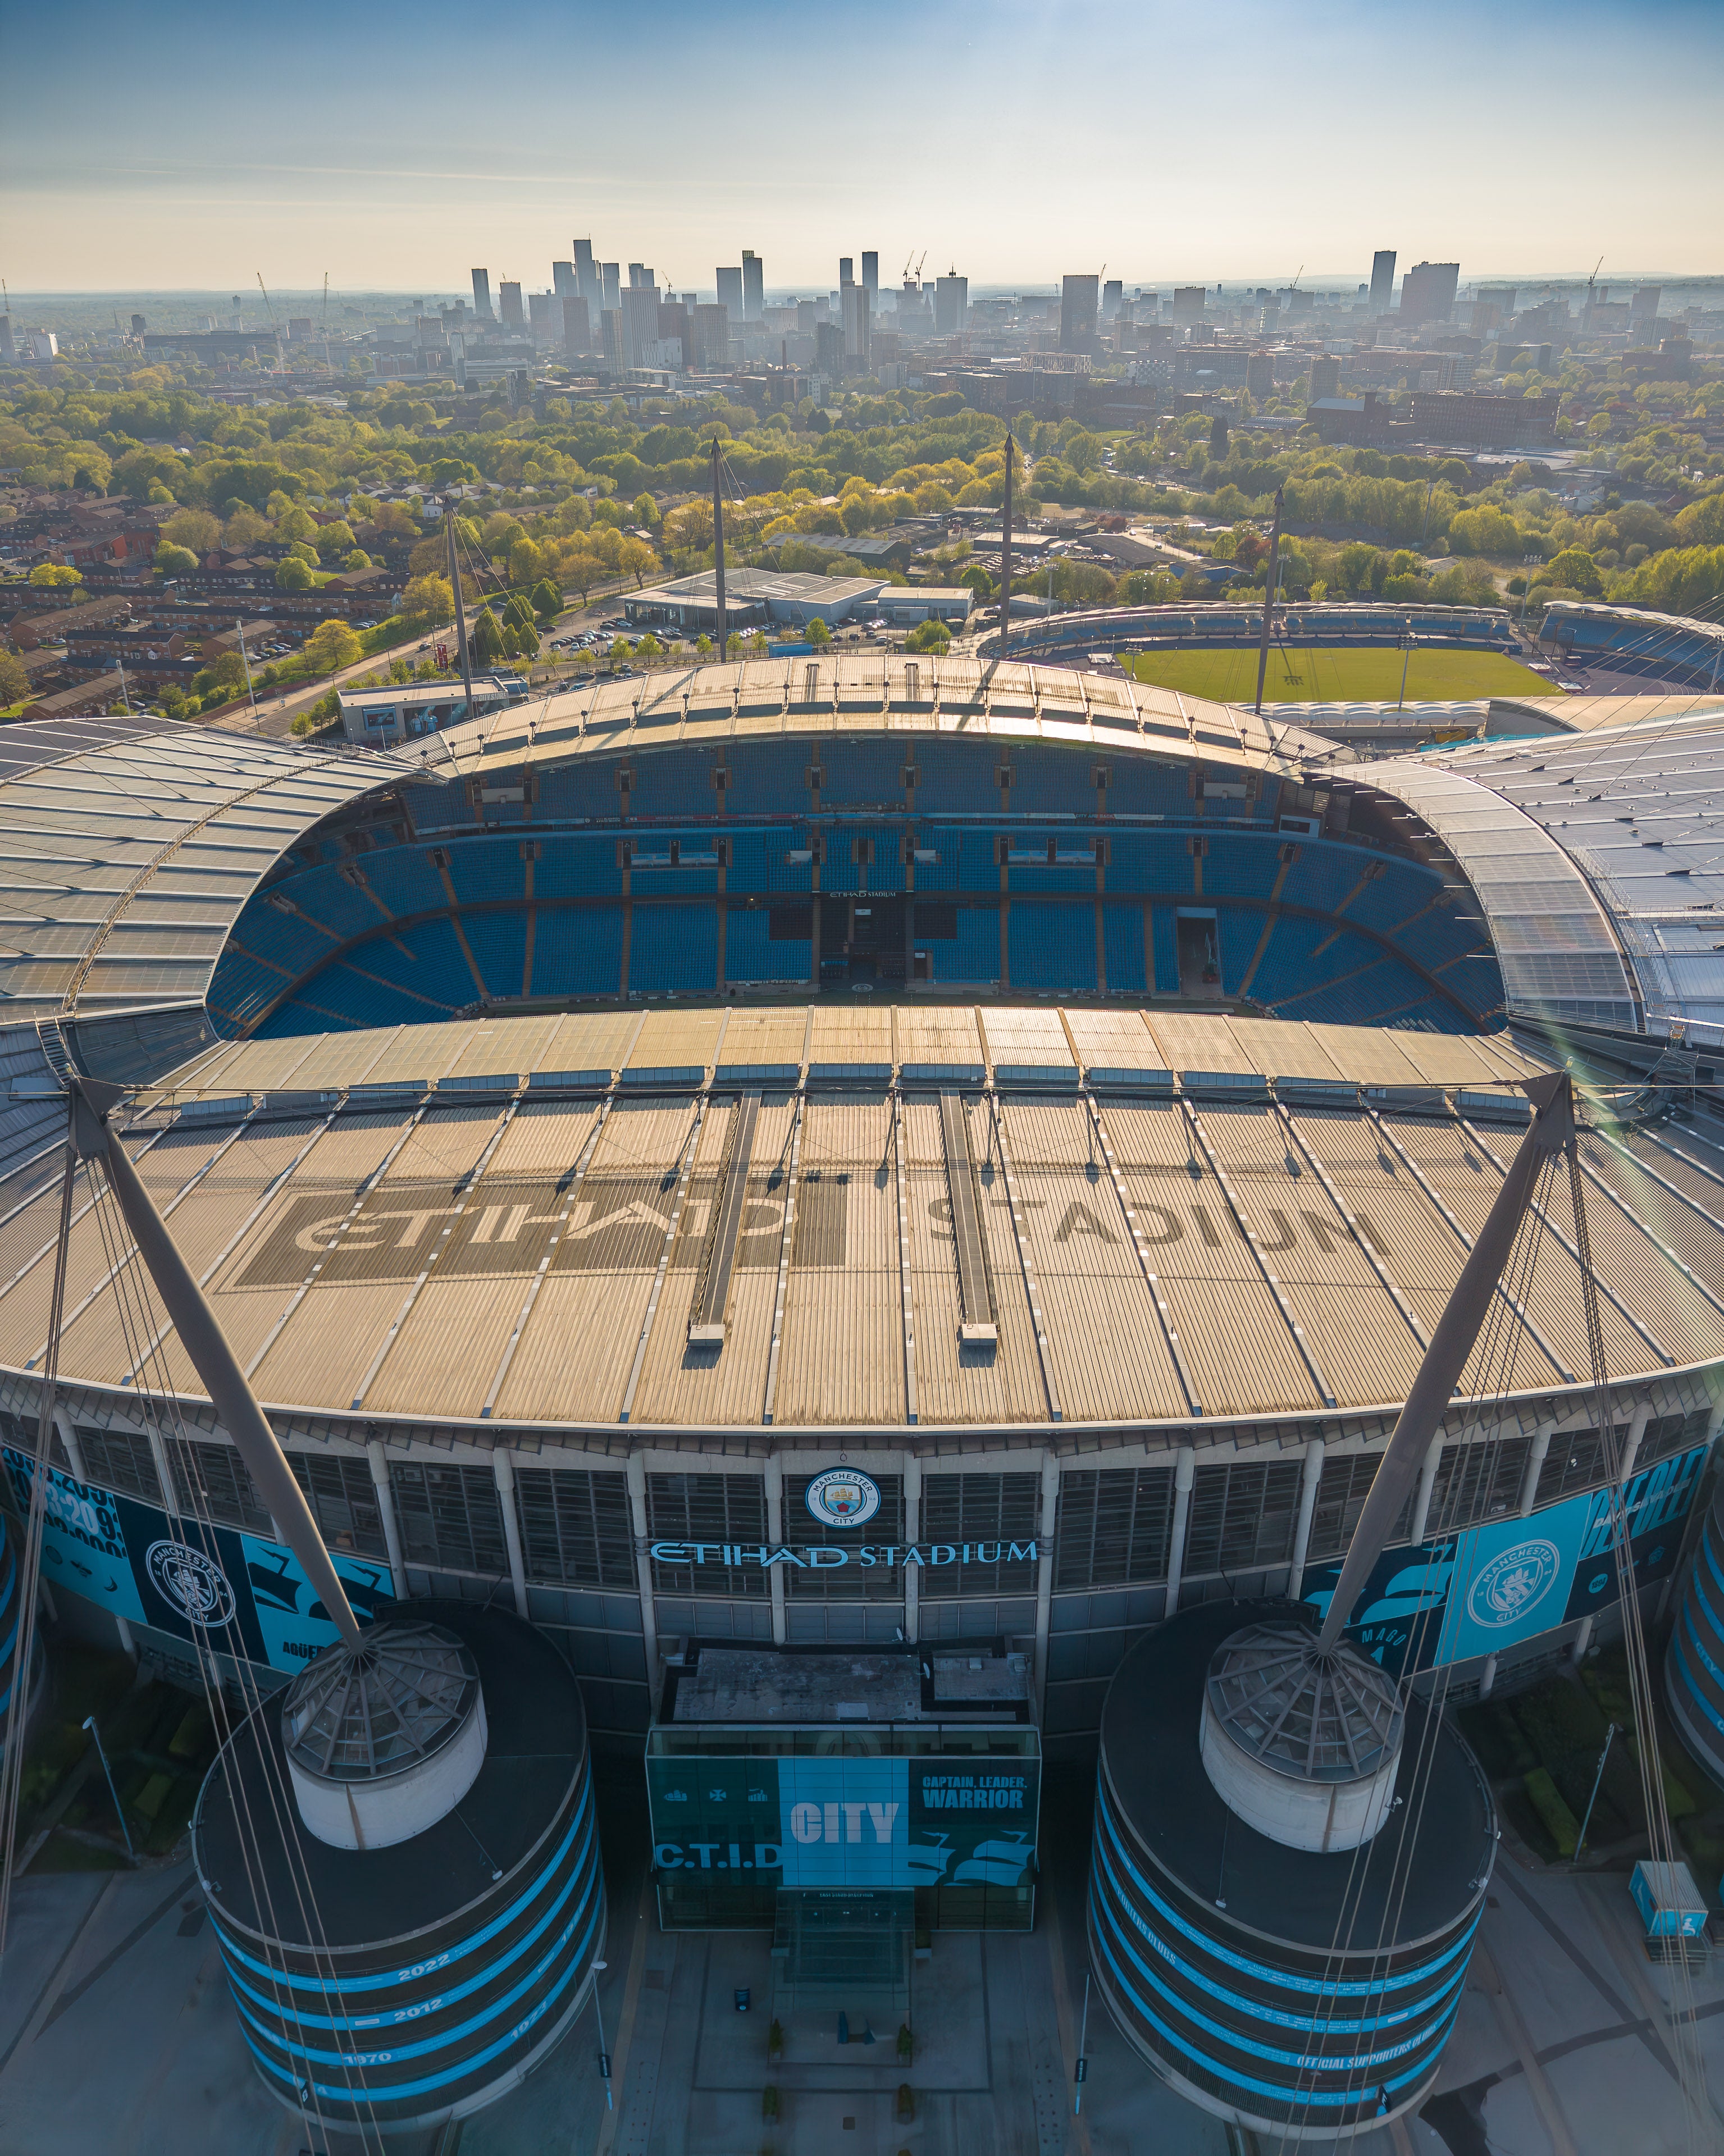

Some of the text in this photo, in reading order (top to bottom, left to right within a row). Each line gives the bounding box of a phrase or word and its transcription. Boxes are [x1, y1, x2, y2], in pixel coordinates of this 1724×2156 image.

[295, 1197, 1392, 1256] ETIHAD STADIUM
[813, 1473, 873, 1492] MANCHESTER
[153, 1547, 221, 1583] MANCHESTER
[650, 1541, 1038, 1567] ETIHAD STADIUM
[1483, 1547, 1553, 1583] MANCHESTER
[185, 1608, 209, 1621] CITY
[1496, 1607, 1521, 1622] CITY
[1362, 1628, 1407, 1646] MAGO
[923, 1789, 1024, 1809] WARRIOR
[791, 1803, 899, 1843] CITY
[398, 1953, 450, 1981] 2022
[394, 1998, 443, 2022] 2012
[1297, 2056, 1345, 2070] OFFICIAL
[1347, 2042, 1411, 2068] SUPPORTERS
